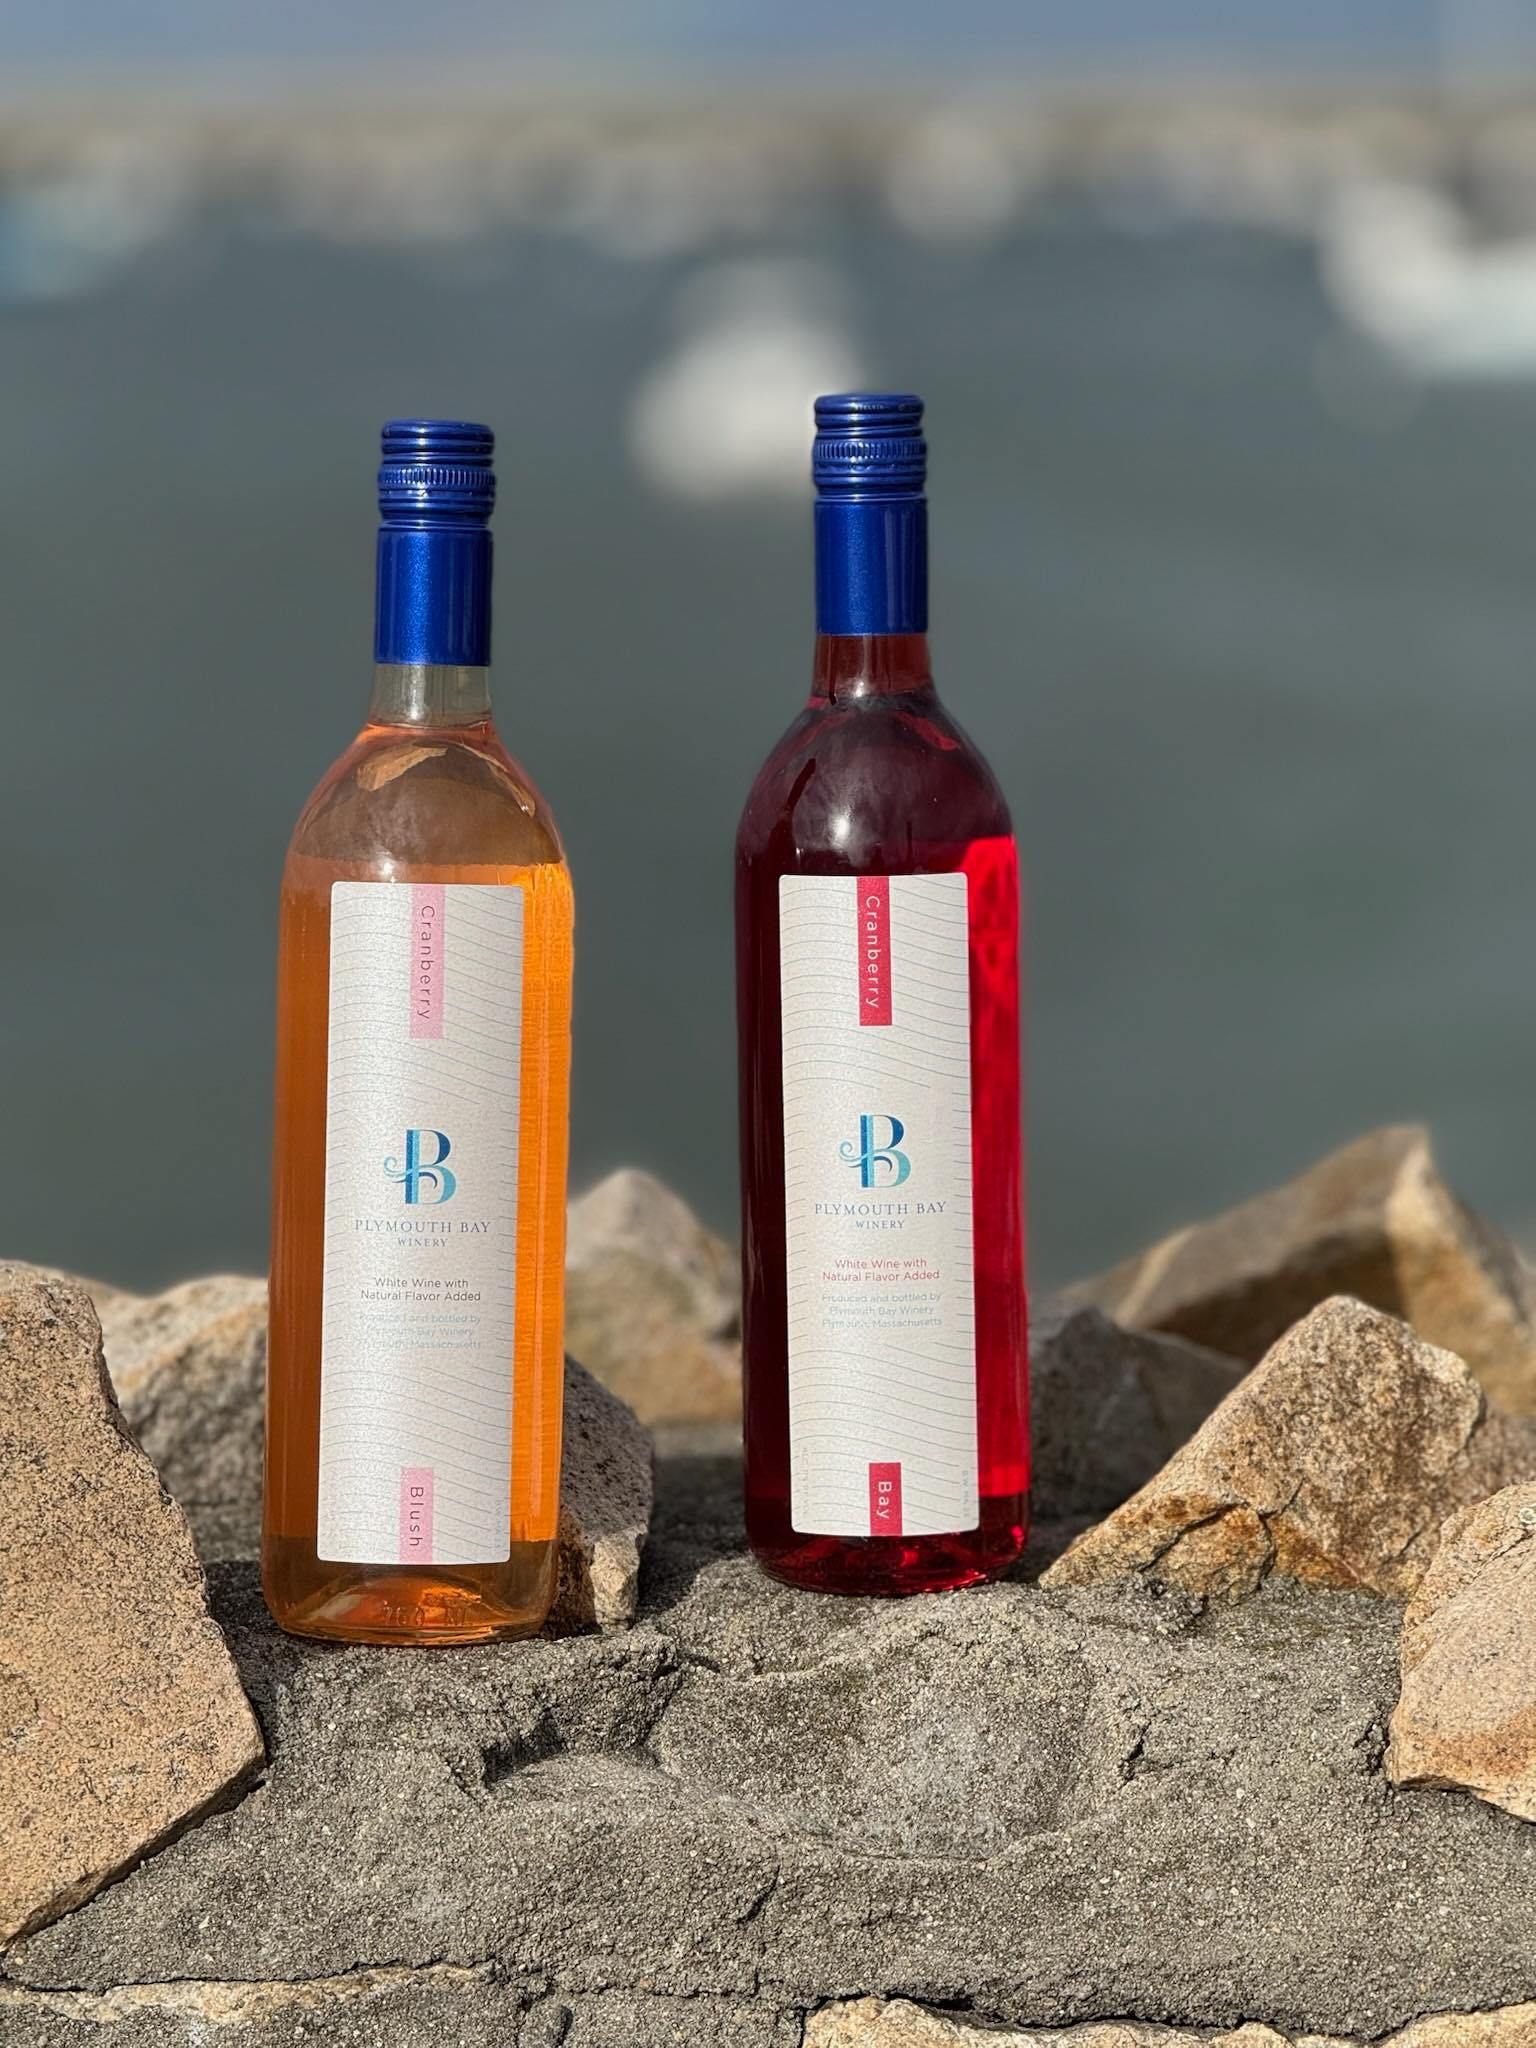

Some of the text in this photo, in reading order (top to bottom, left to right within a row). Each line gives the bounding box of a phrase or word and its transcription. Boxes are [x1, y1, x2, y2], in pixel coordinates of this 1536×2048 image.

[865, 895, 882, 1009] Cranberry
[416, 905, 436, 1020] Cranberry
[815, 1201, 947, 1216] PLYMOUTH BAY
[355, 1219, 491, 1233] PLYMOUTH BAY
[856, 1220, 905, 1230] WINERY
[398, 1237, 448, 1248] WINERY
[835, 1257, 928, 1269] White Wine with
[822, 1270, 941, 1281] Natural Flavor Added
[375, 1277, 469, 1289] White Wine with
[360, 1290, 481, 1302] Natural Flavor Added
[892, 1292, 927, 1302] bottled
[929, 1292, 941, 1303] by
[878, 1306, 897, 1316] Bay
[900, 1305, 935, 1315] Winery
[876, 1481, 893, 1520] Bay
[409, 1486, 425, 1547] Blush
